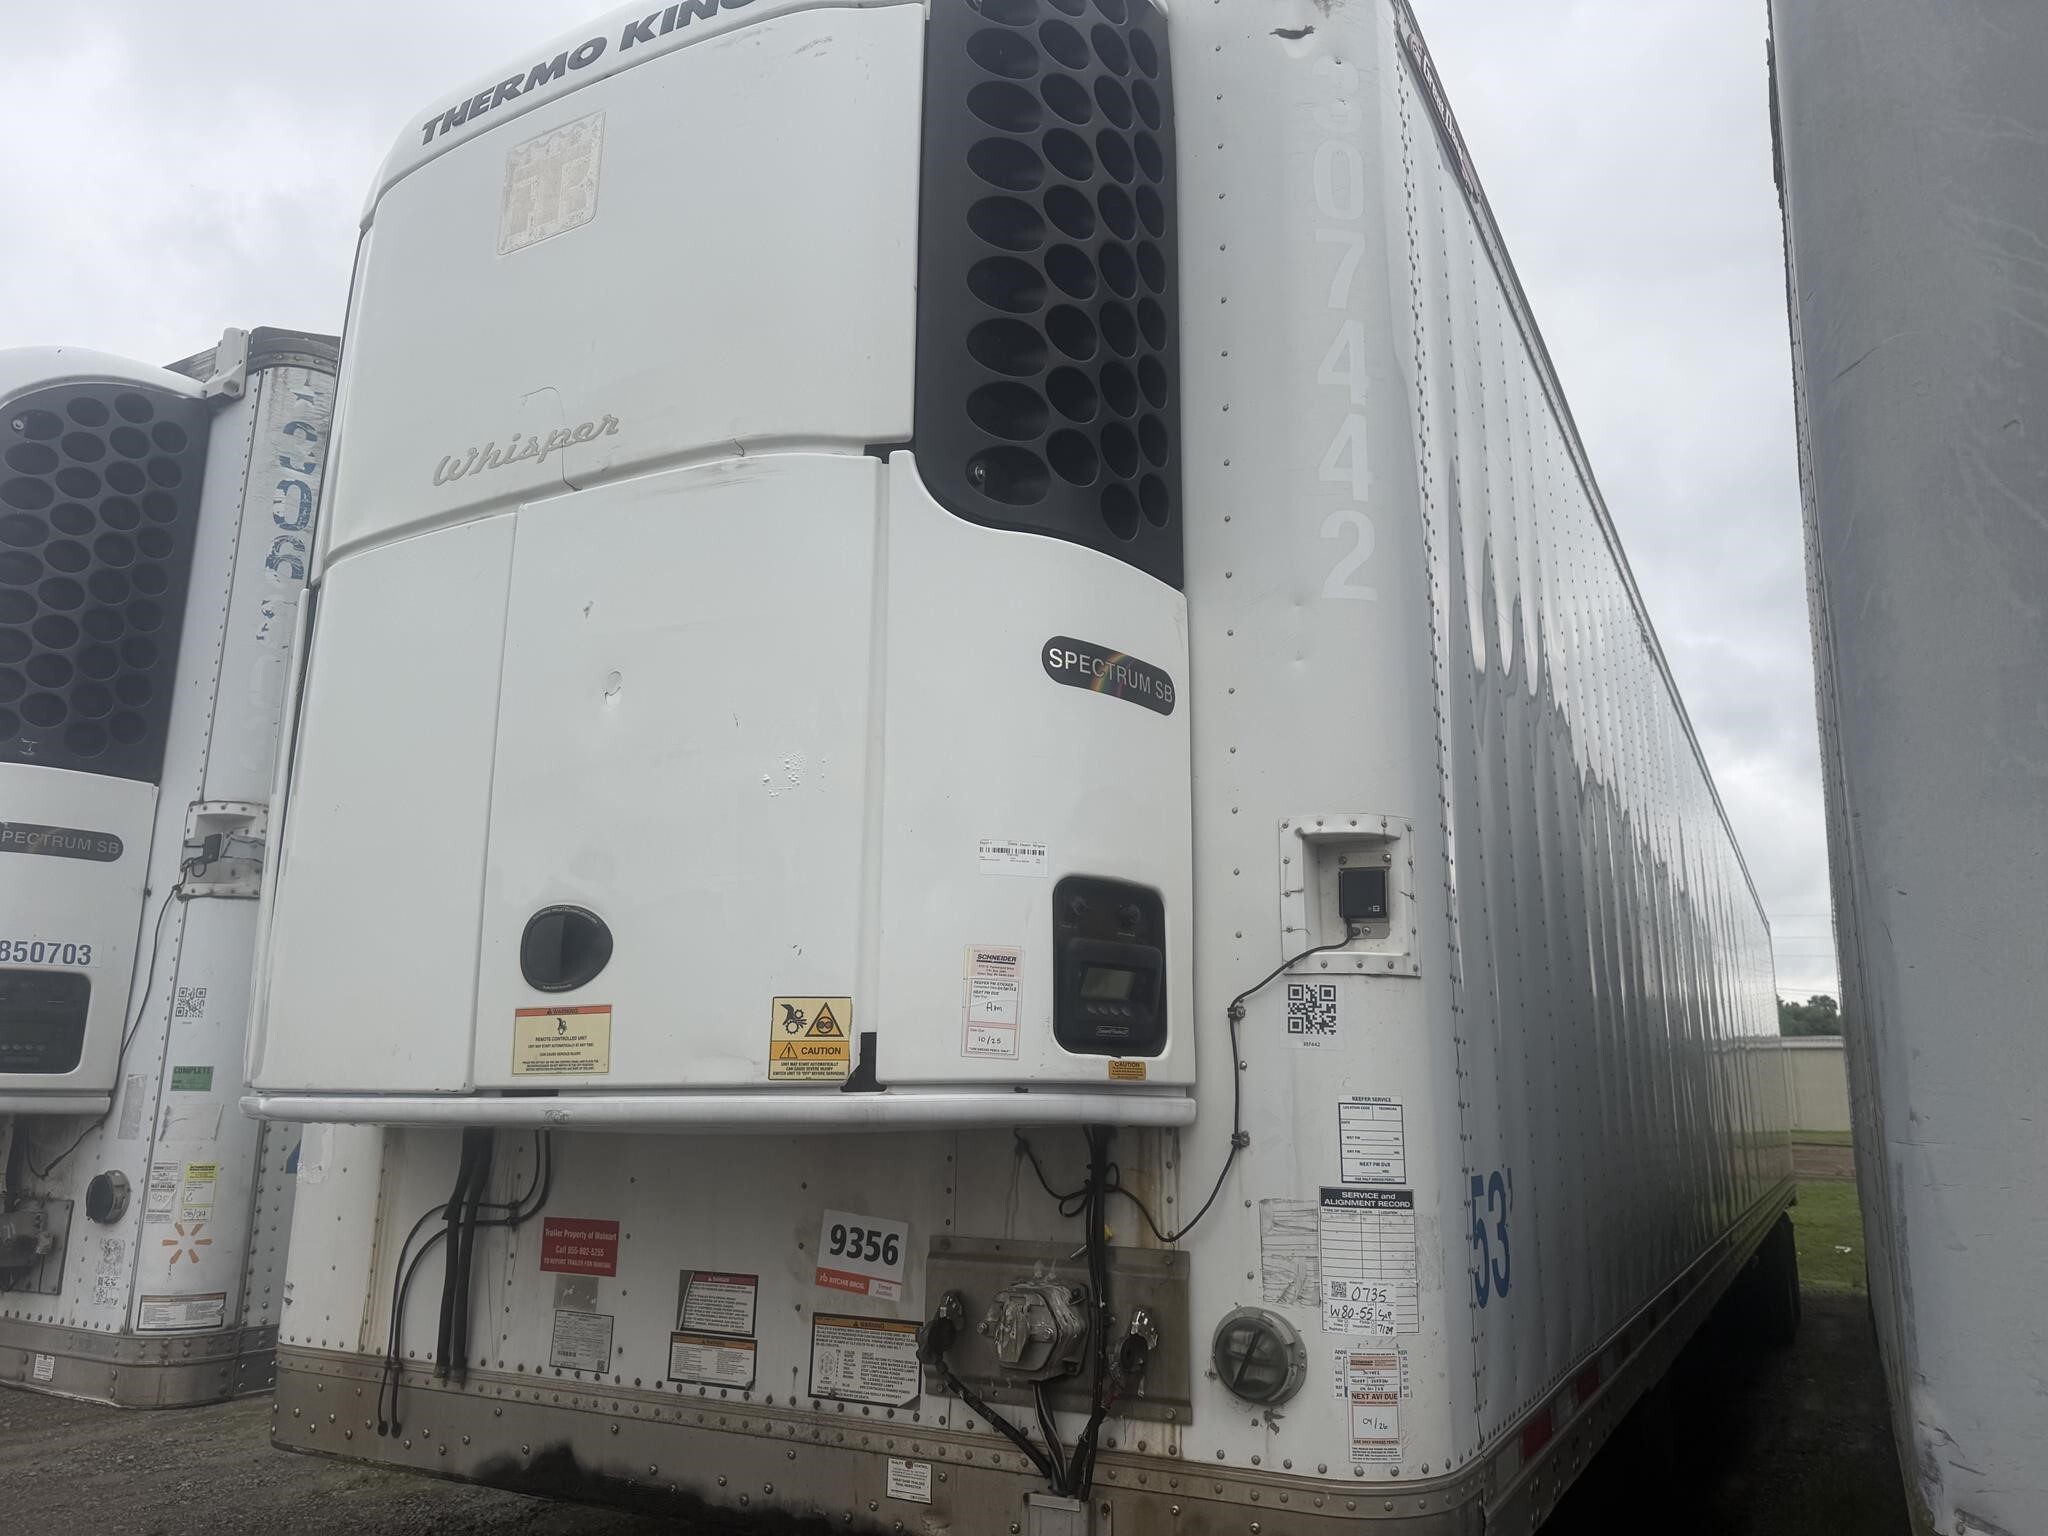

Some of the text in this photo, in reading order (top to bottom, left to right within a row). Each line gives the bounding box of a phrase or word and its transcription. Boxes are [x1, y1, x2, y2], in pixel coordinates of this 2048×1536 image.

[421, 36, 607, 145] THERMO
[433, 414, 619, 486] Whisper
[1049, 647, 1173, 703] SPECTRUM SB
[97, 841, 119, 855] SB
[0, 940, 92, 966] 850703
[977, 953, 1017, 962] SCHNEIDER
[801, 1047, 841, 1055] CAUTION
[1324, 1199, 1377, 1207] ALIGNMENT
[830, 1224, 899, 1266] 9356
[1351, 1286, 1387, 1303] 0735
